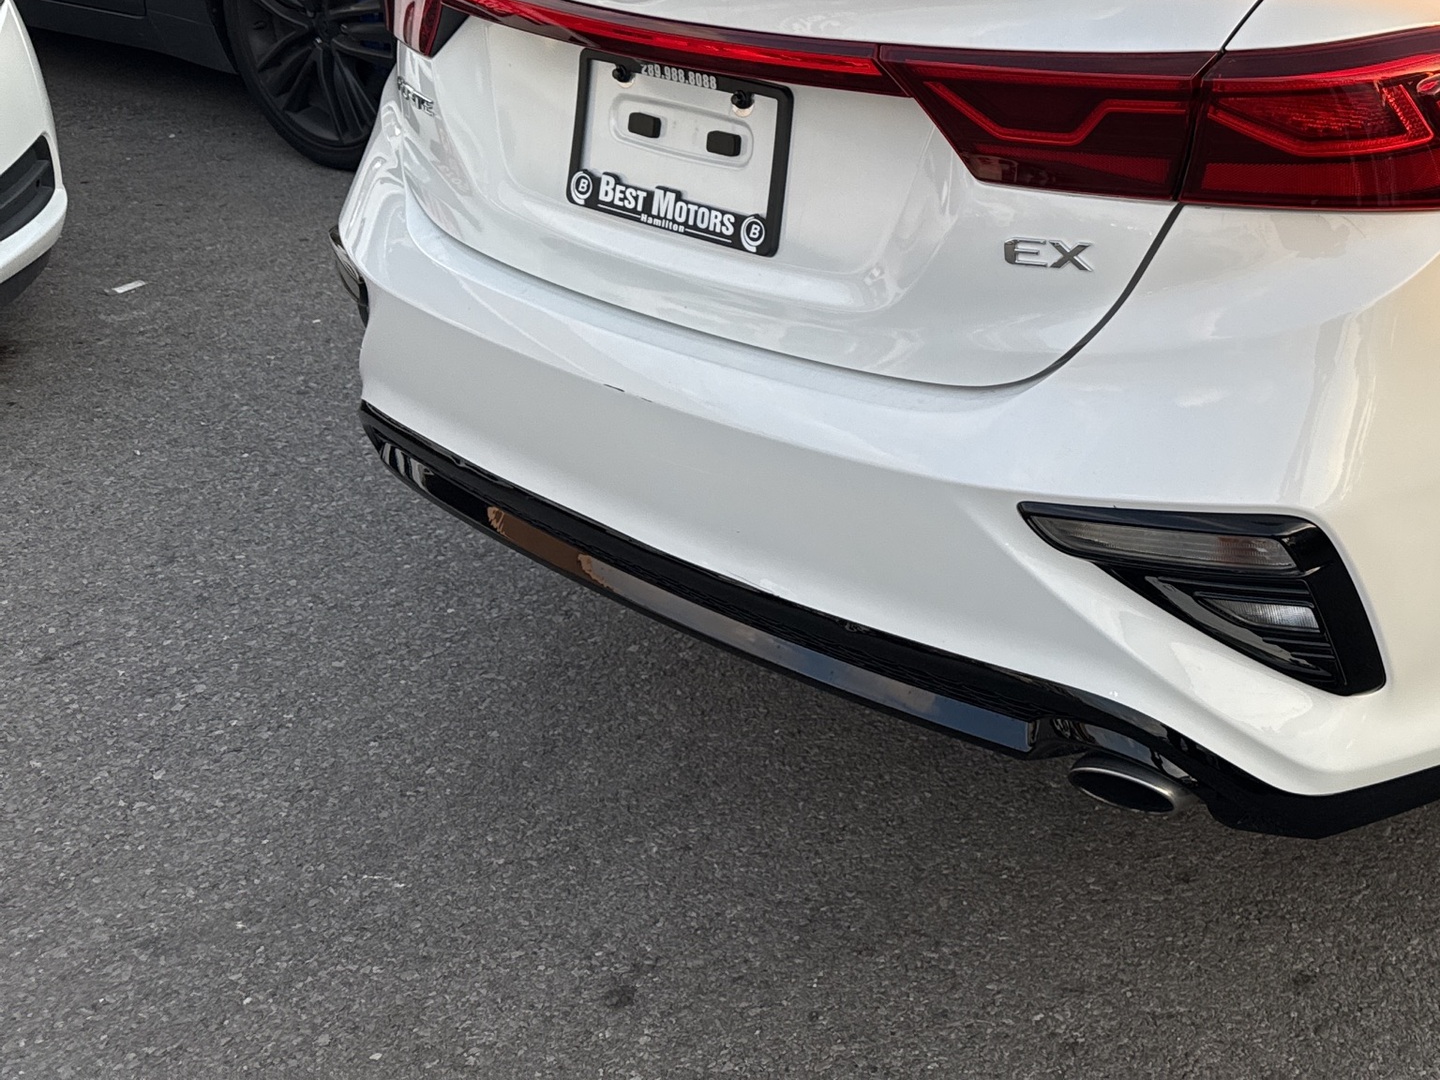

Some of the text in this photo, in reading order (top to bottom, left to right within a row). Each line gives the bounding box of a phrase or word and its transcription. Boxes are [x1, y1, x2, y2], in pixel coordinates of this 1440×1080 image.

[640, 64, 717, 90] 289.988.8088
[598, 174, 735, 236] BEST MOTORS
[640, 213, 685, 233] Hamilton
[1004, 236, 1094, 272] EX
